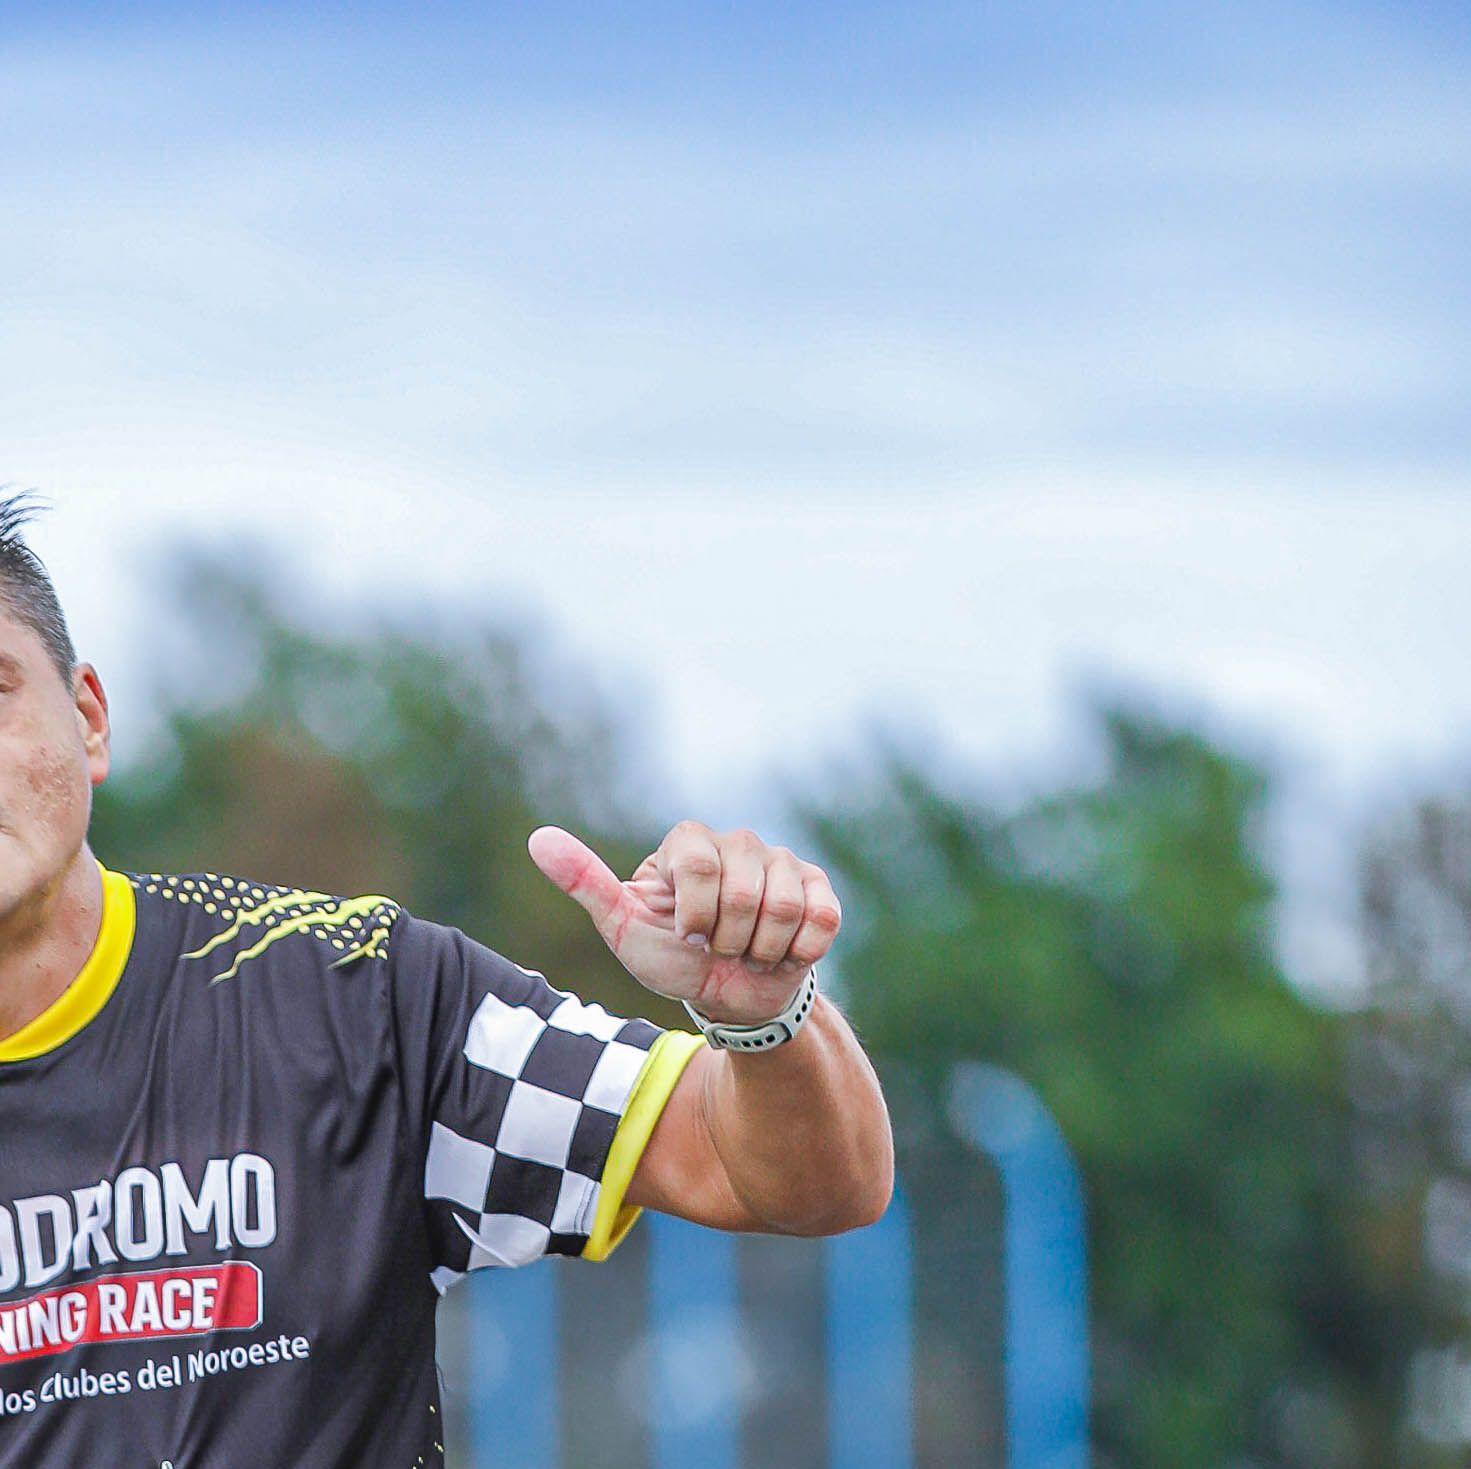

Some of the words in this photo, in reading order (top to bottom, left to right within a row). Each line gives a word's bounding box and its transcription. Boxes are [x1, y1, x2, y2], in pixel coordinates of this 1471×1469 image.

[97, 1277, 219, 1335] RACE
[137, 1355, 182, 1391] del
[187, 1334, 310, 1383] Noroeste
